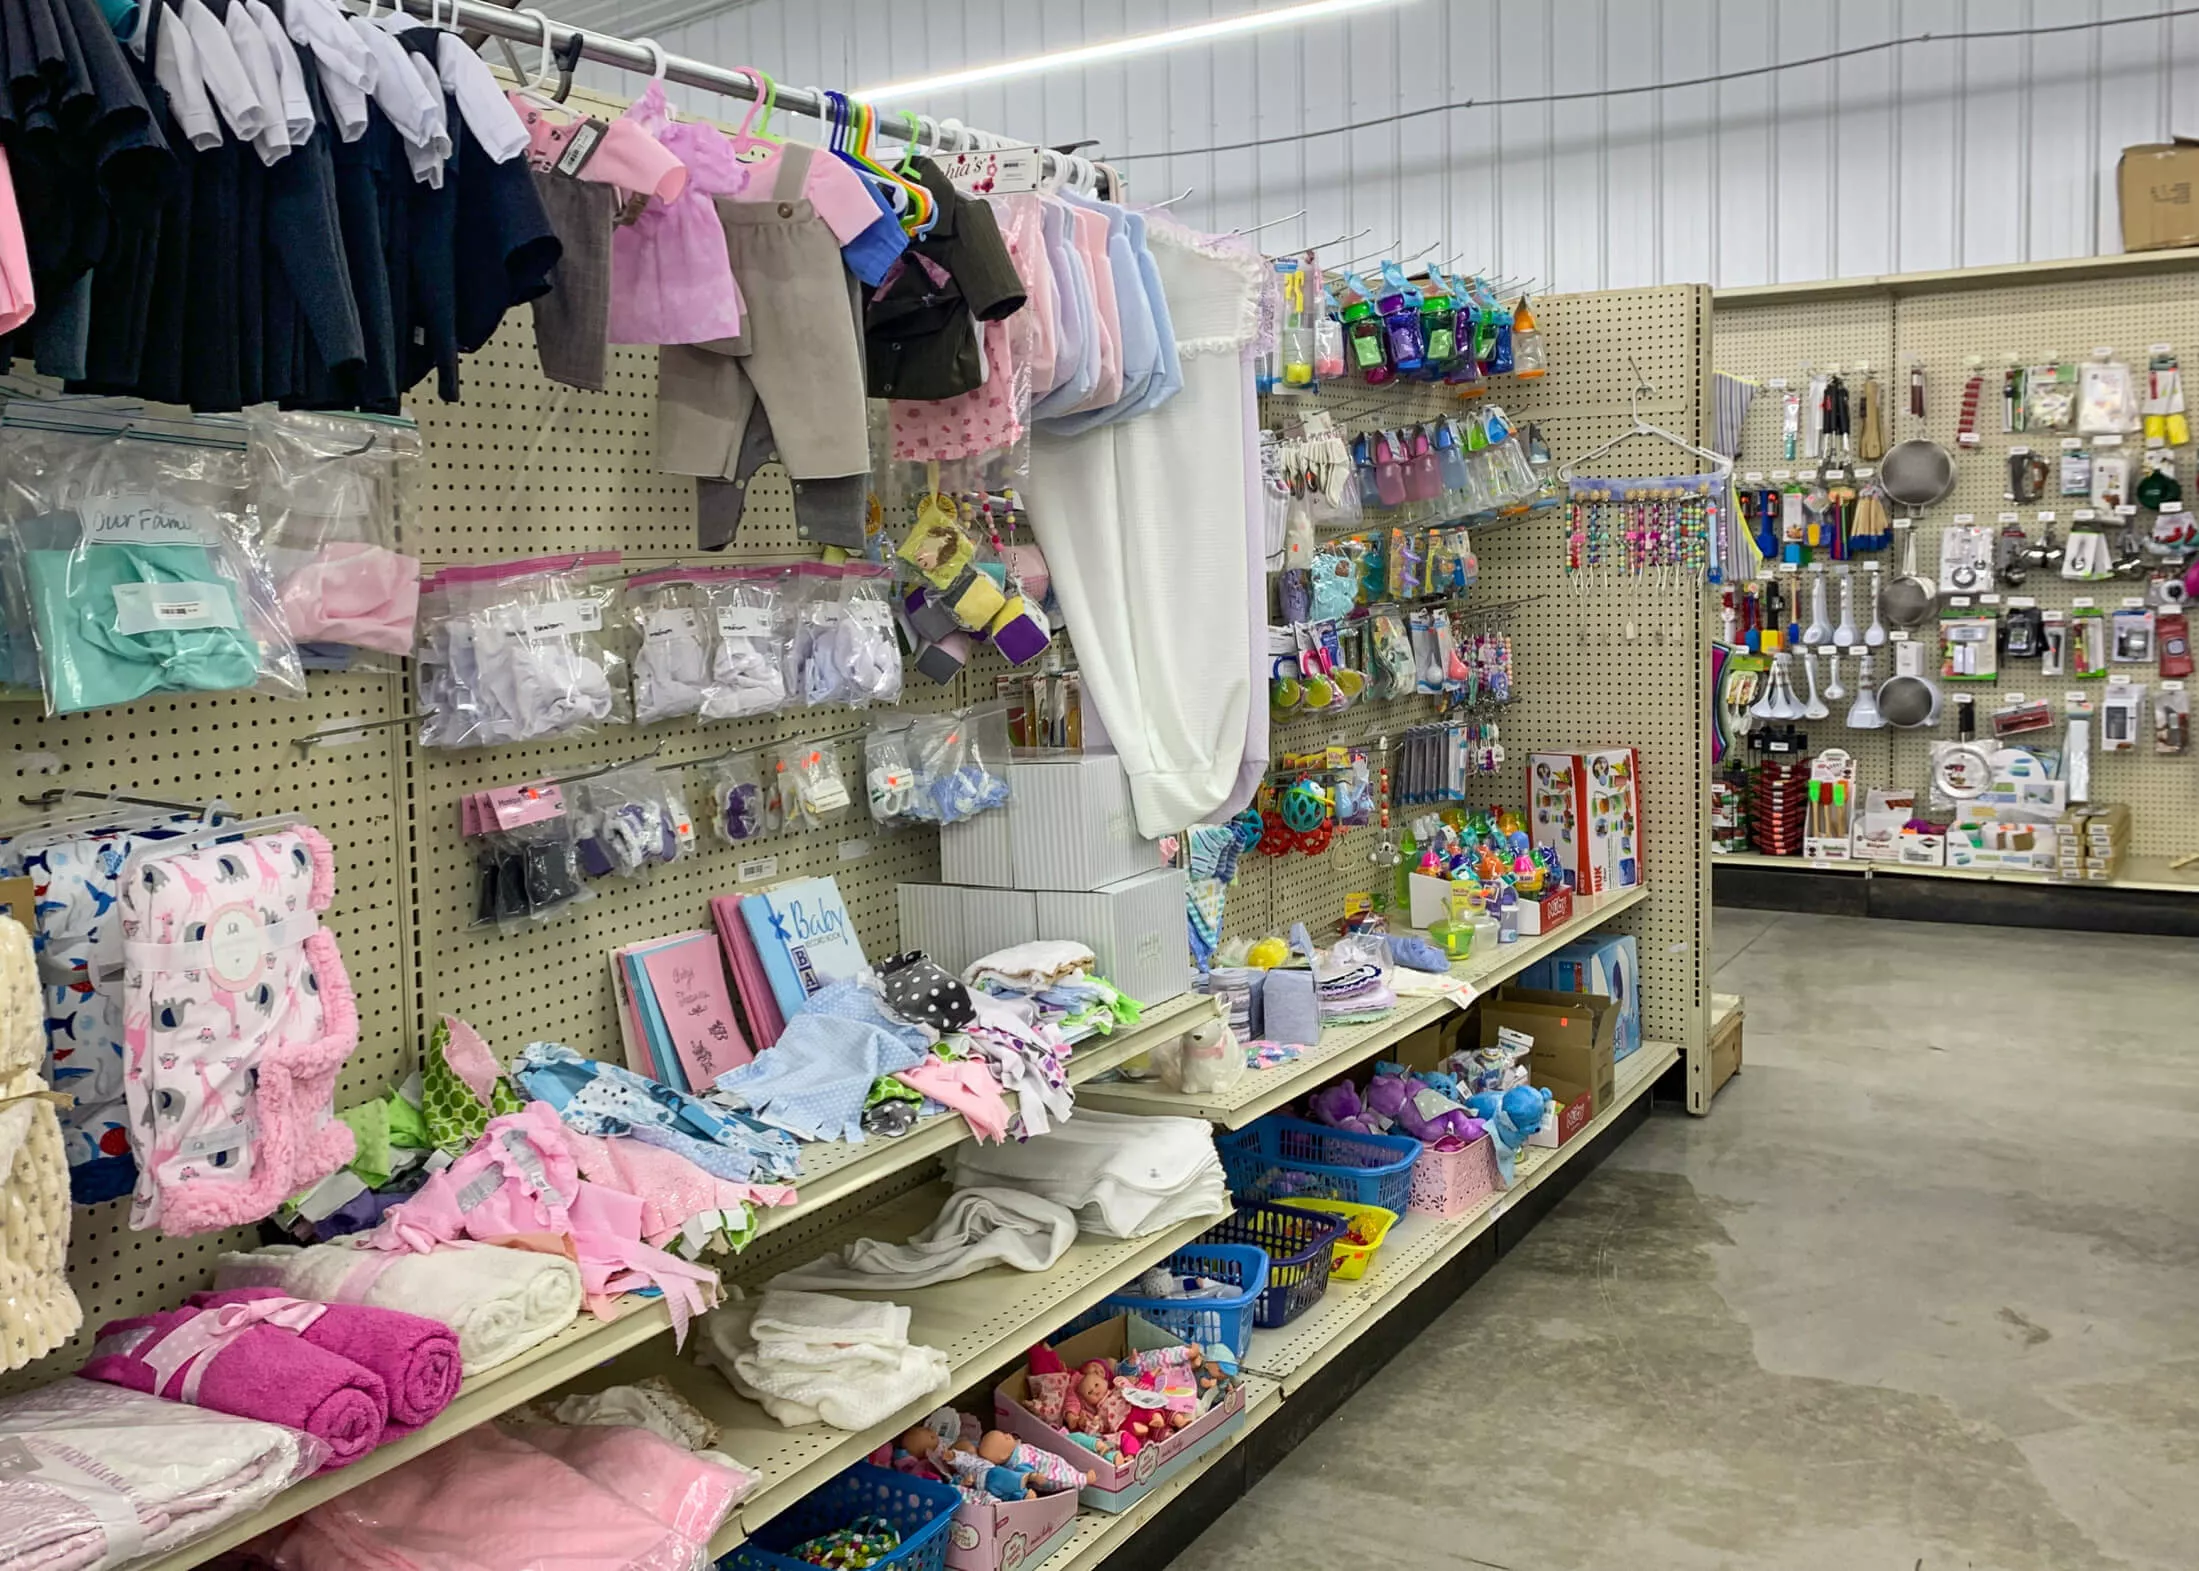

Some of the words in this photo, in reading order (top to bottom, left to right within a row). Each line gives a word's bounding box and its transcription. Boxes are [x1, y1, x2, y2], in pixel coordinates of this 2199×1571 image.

[944, 156, 982, 179] hia's
[138, 508, 192, 531] Fami
[790, 897, 849, 946] Baby
